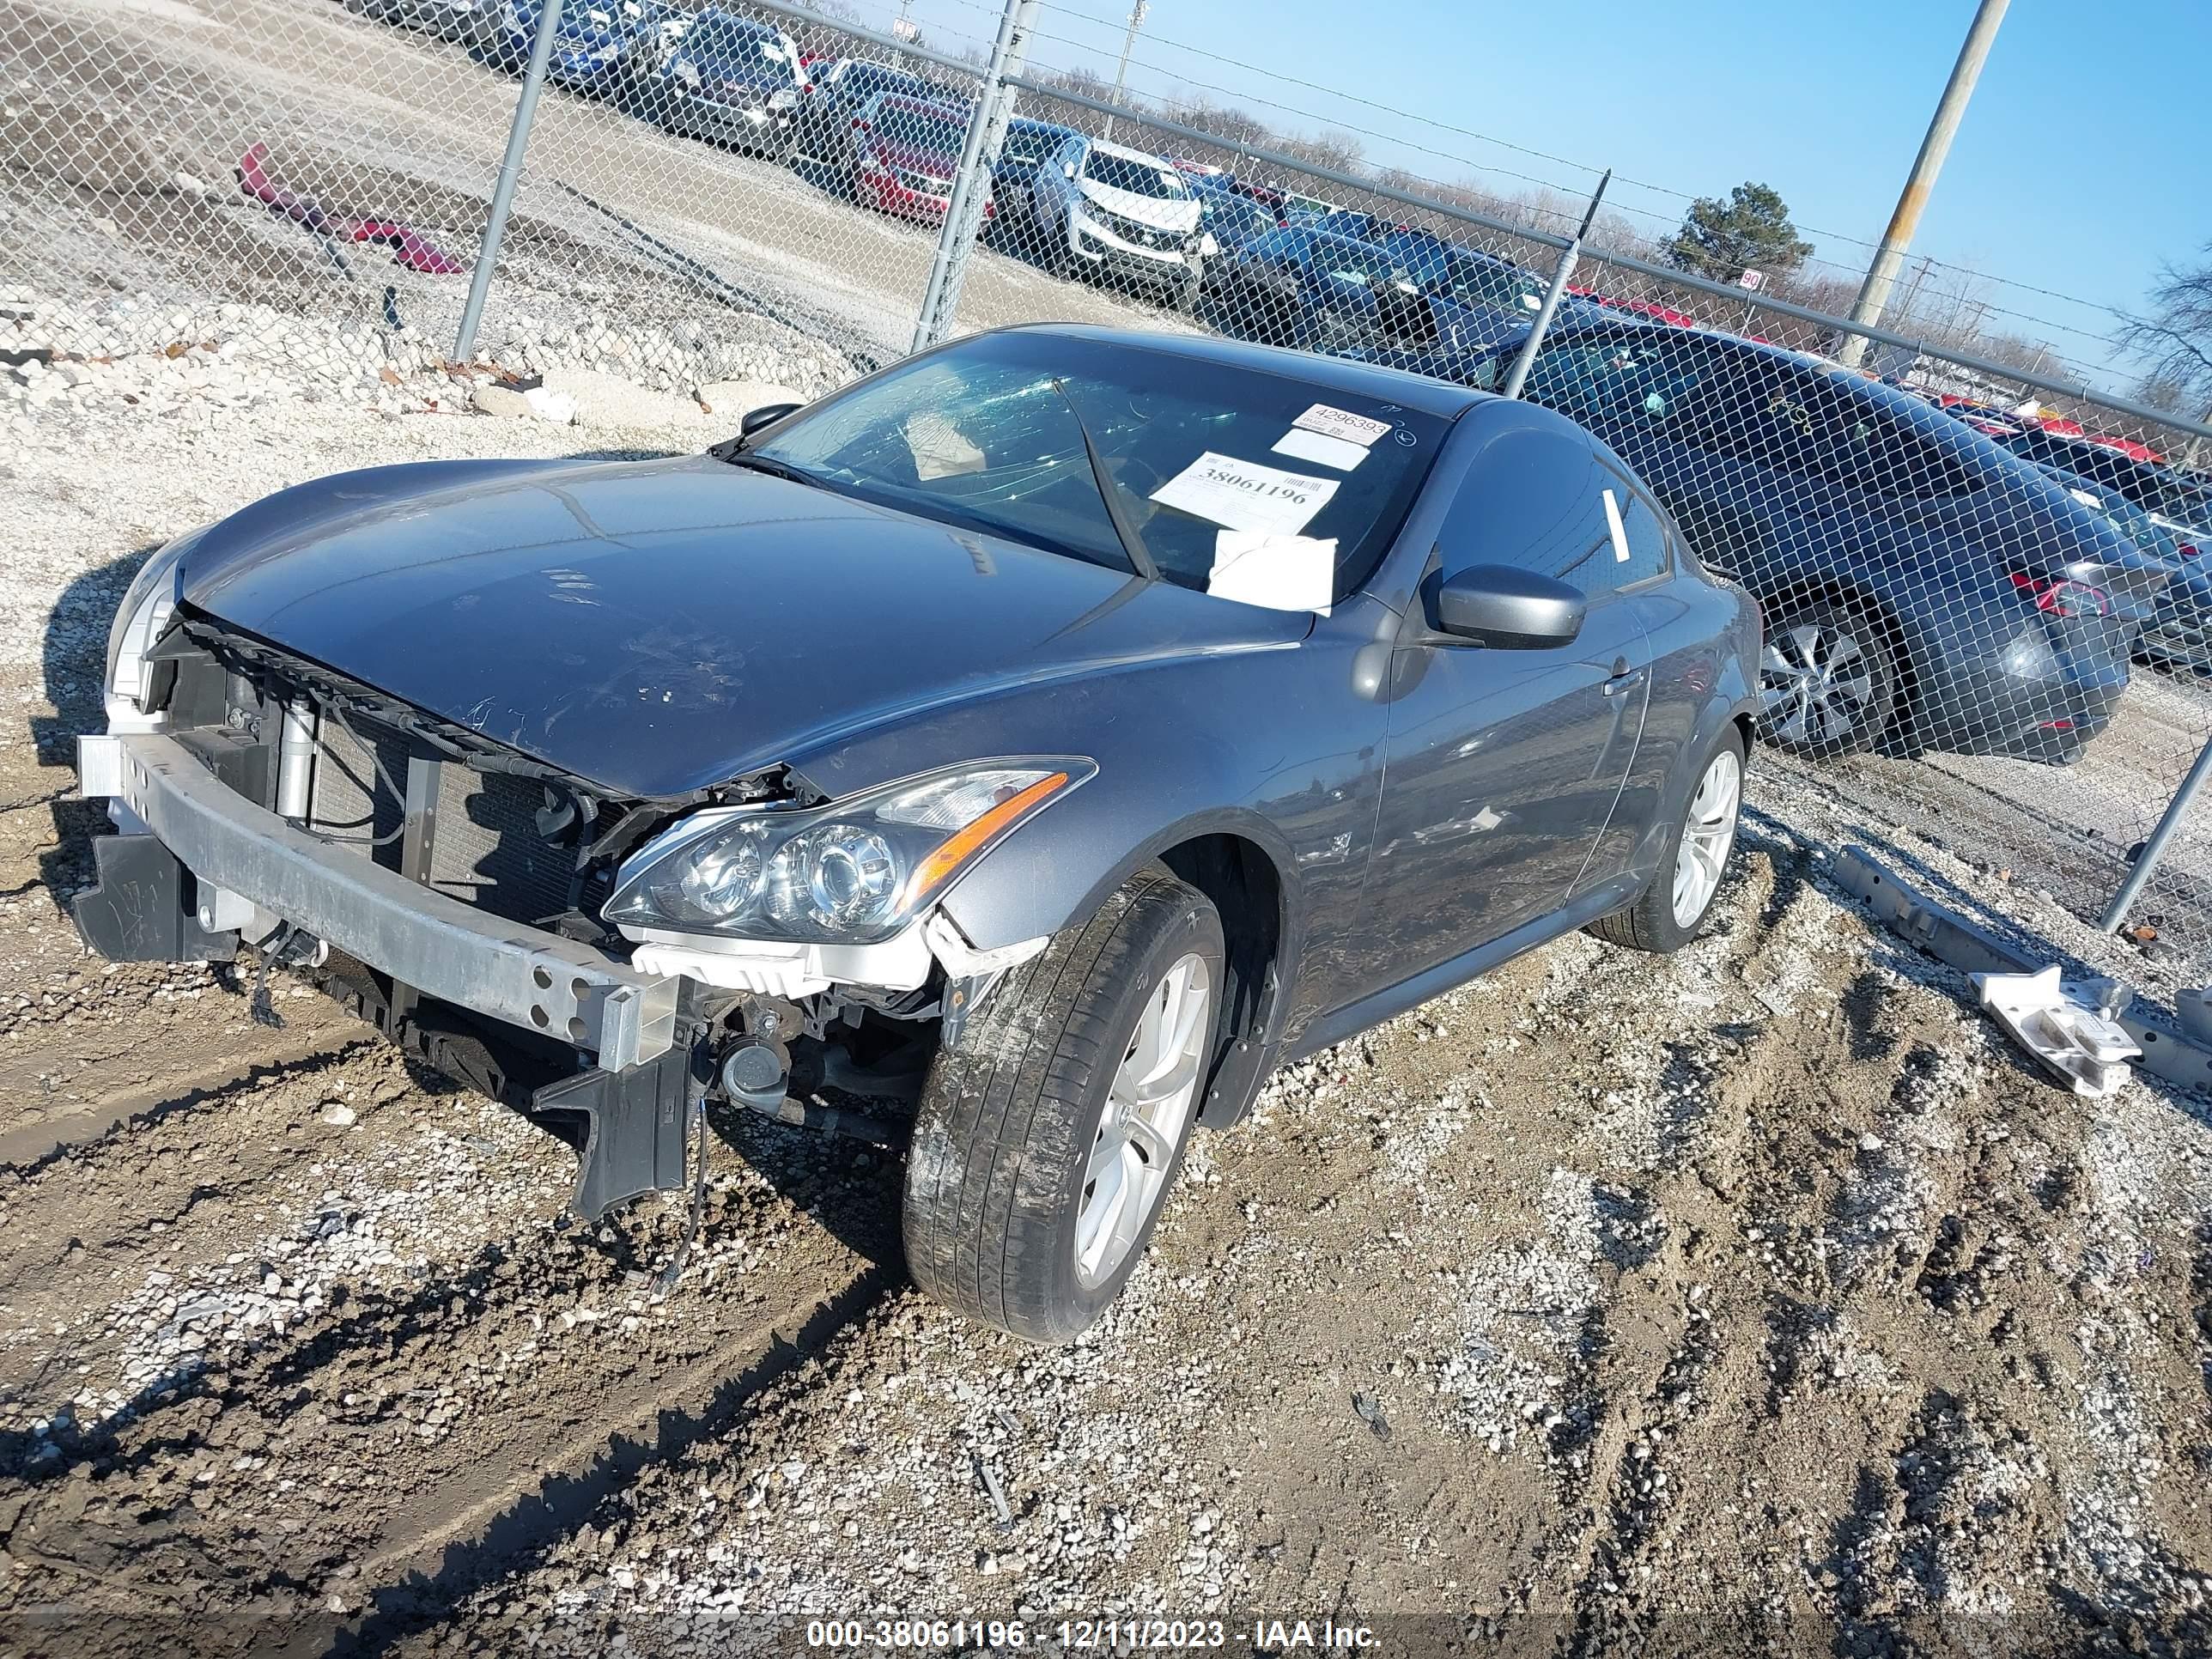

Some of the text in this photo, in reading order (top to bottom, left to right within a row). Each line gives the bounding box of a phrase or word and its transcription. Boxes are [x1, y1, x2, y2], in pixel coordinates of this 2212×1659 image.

[1742, 272, 1759, 286] 90
[1316, 408, 1387, 434] 4296393
[1198, 468, 1310, 505] 38061196
